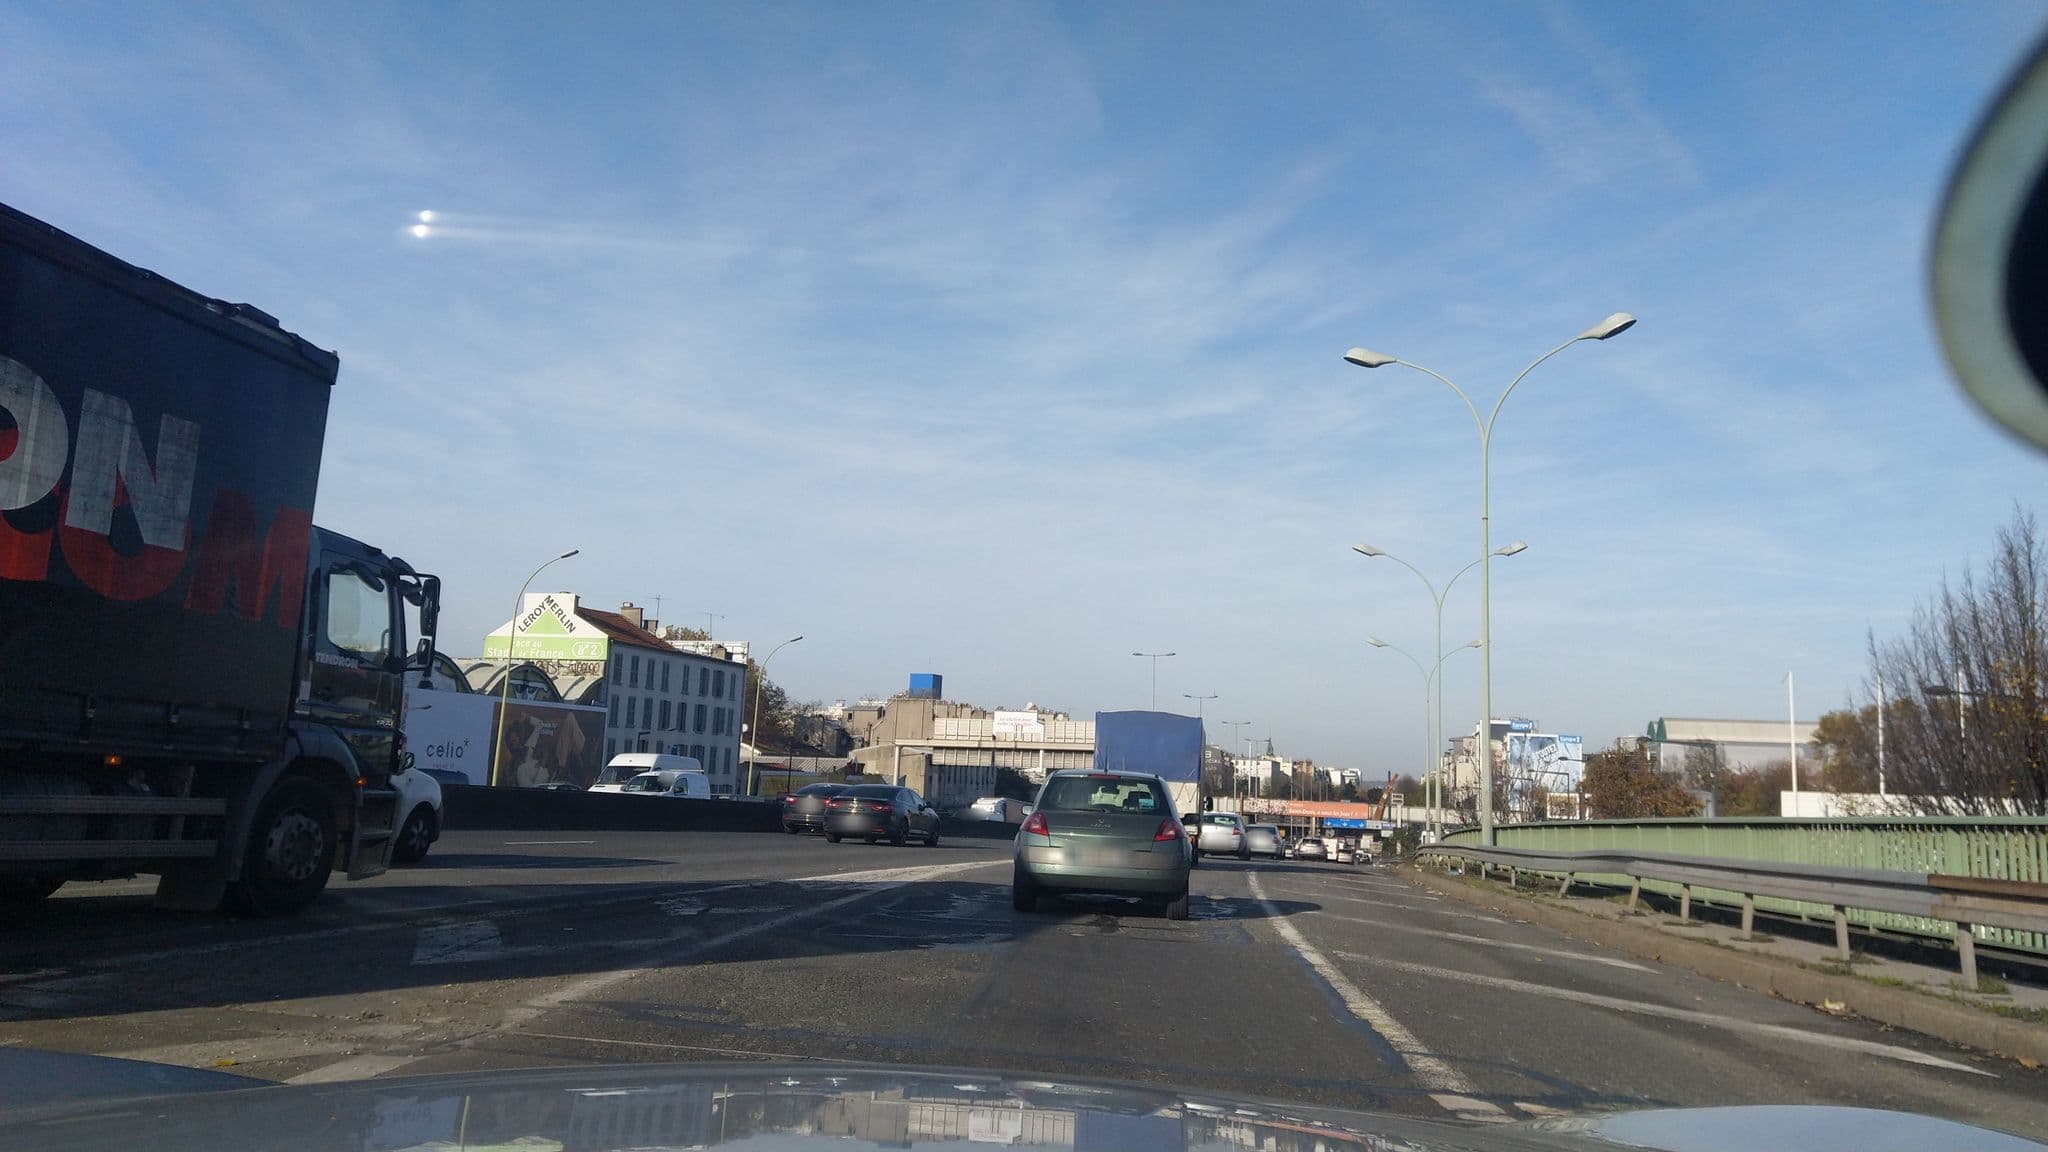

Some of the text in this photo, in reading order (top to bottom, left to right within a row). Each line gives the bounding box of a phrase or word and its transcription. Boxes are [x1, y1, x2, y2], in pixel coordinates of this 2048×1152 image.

[518, 594, 577, 634] LEROY MERLIN
[314, 651, 360, 670] TENDRON
[487, 646, 515, 658] Stad
[530, 648, 565, 659] France
